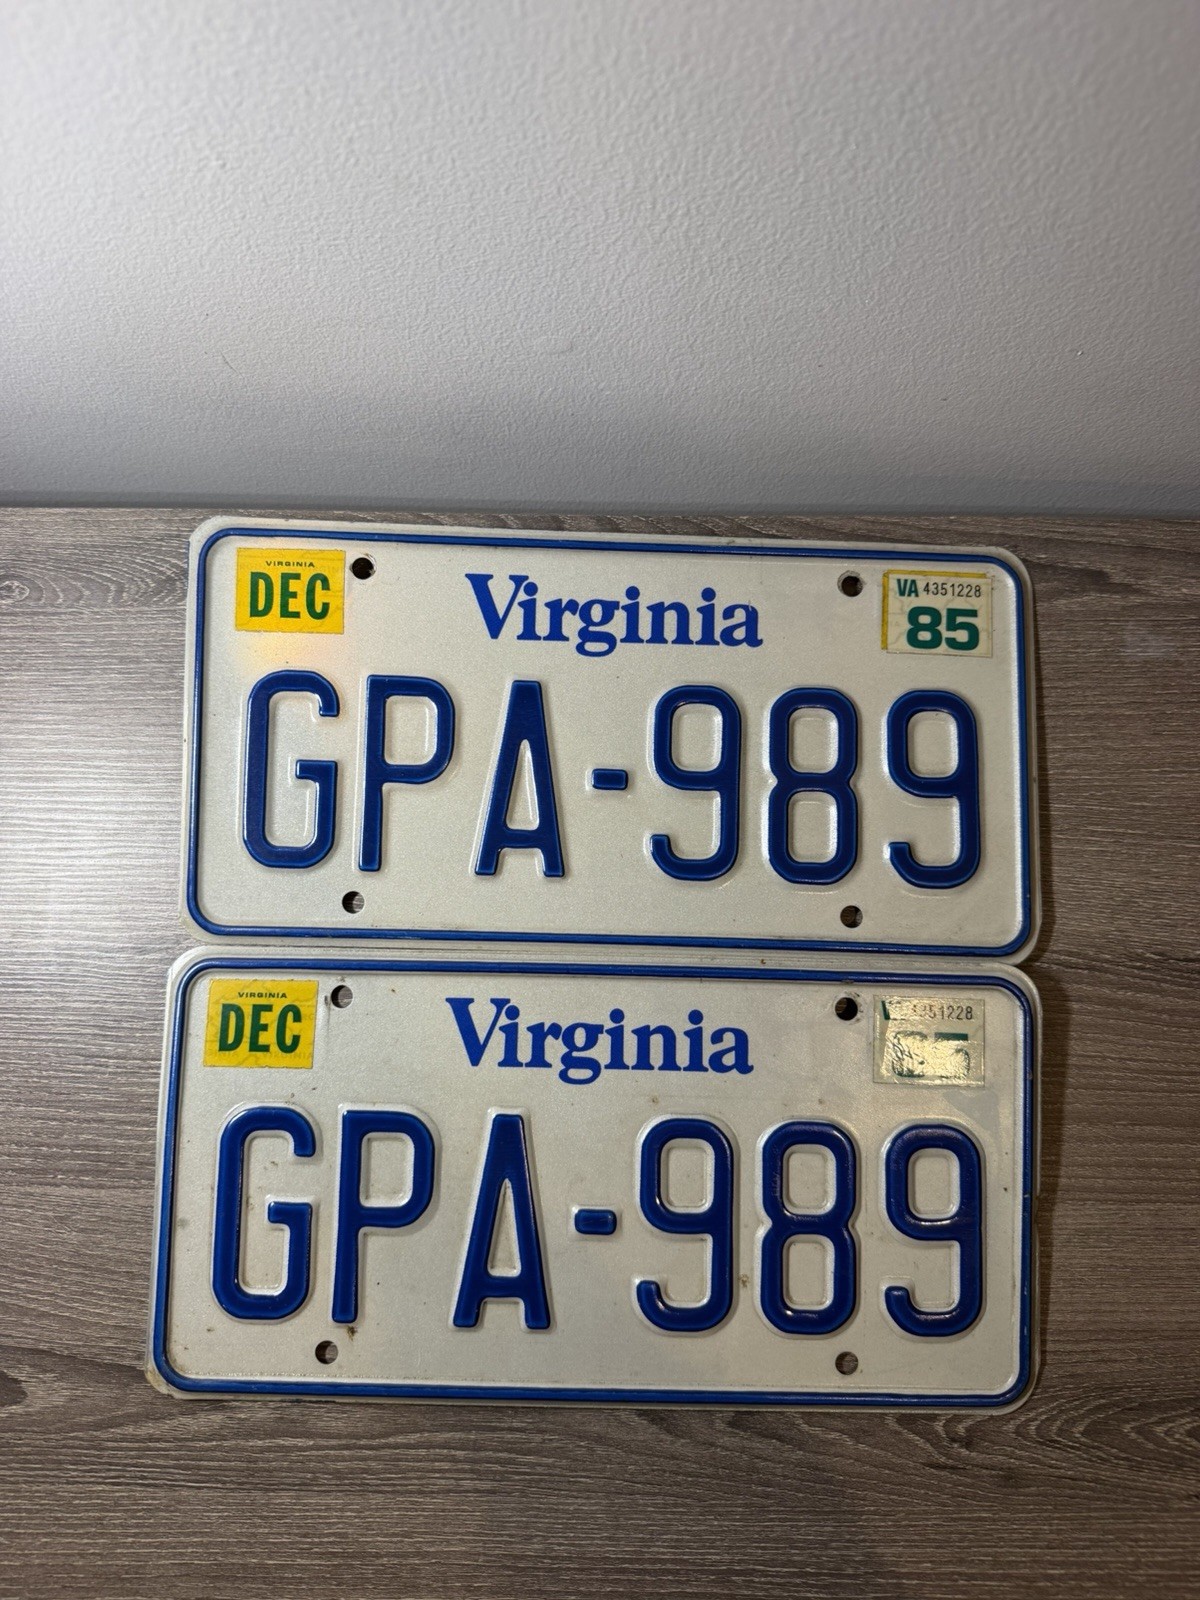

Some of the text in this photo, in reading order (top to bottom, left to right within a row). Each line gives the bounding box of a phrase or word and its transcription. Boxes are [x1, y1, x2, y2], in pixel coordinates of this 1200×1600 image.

[265, 560, 315, 568] VIRGINIA
[896, 578, 982, 598] VA 4351228
[249, 571, 331, 620] DEC
[466, 573, 762, 656] Virginia
[906, 606, 980, 651] 85
[243, 670, 981, 889] GPA-989
[218, 1003, 302, 1054] DEC
[446, 997, 753, 1085] Virginia
[212, 1106, 982, 1336] GPA-989
